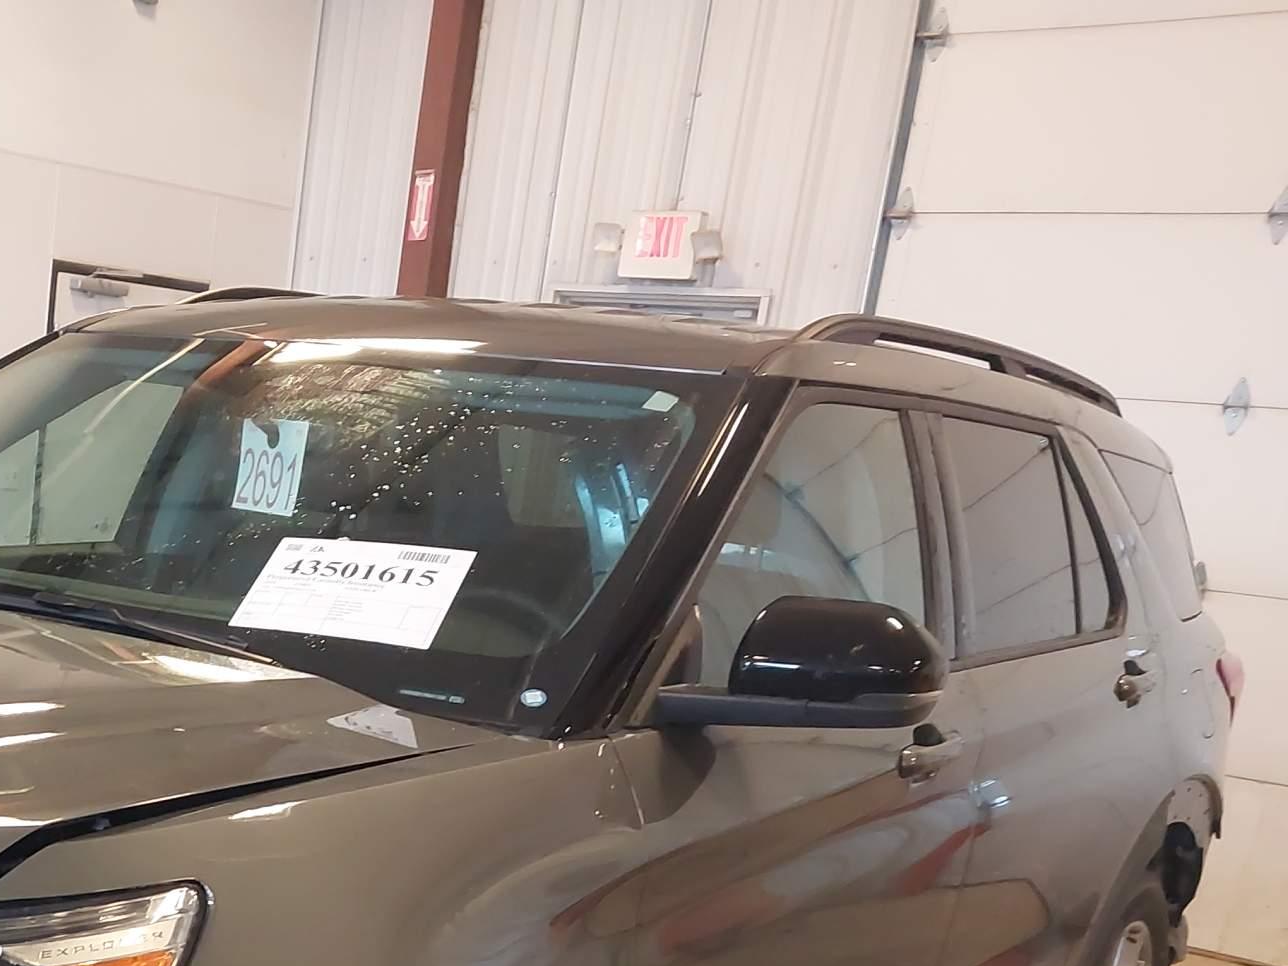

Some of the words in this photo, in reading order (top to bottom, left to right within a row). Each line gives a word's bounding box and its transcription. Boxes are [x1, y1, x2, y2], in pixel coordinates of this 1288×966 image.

[635, 215, 689, 258] EXIT
[234, 447, 299, 511] 2691
[283, 558, 441, 588] 43501615
